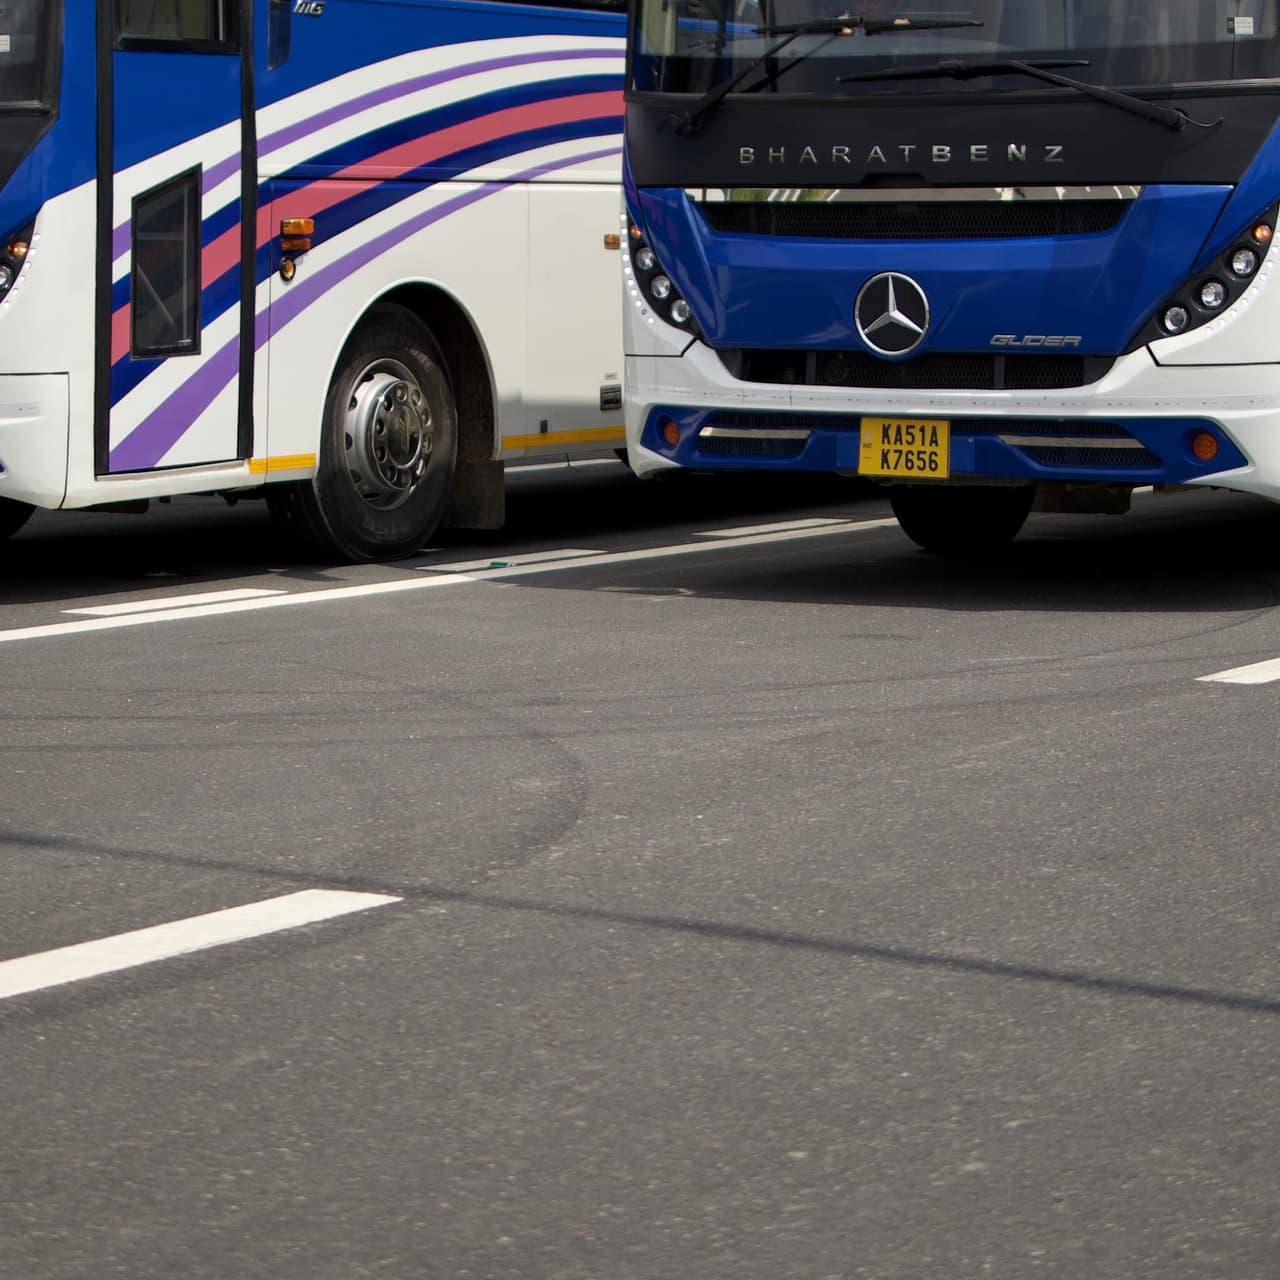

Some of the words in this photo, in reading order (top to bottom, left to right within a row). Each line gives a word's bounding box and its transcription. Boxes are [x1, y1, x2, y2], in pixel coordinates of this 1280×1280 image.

[739, 143, 1064, 164] BHARATBENZ
[990, 334, 1082, 347] GLIDER
[881, 423, 939, 447] KA51A
[880, 448, 939, 472] K7656
